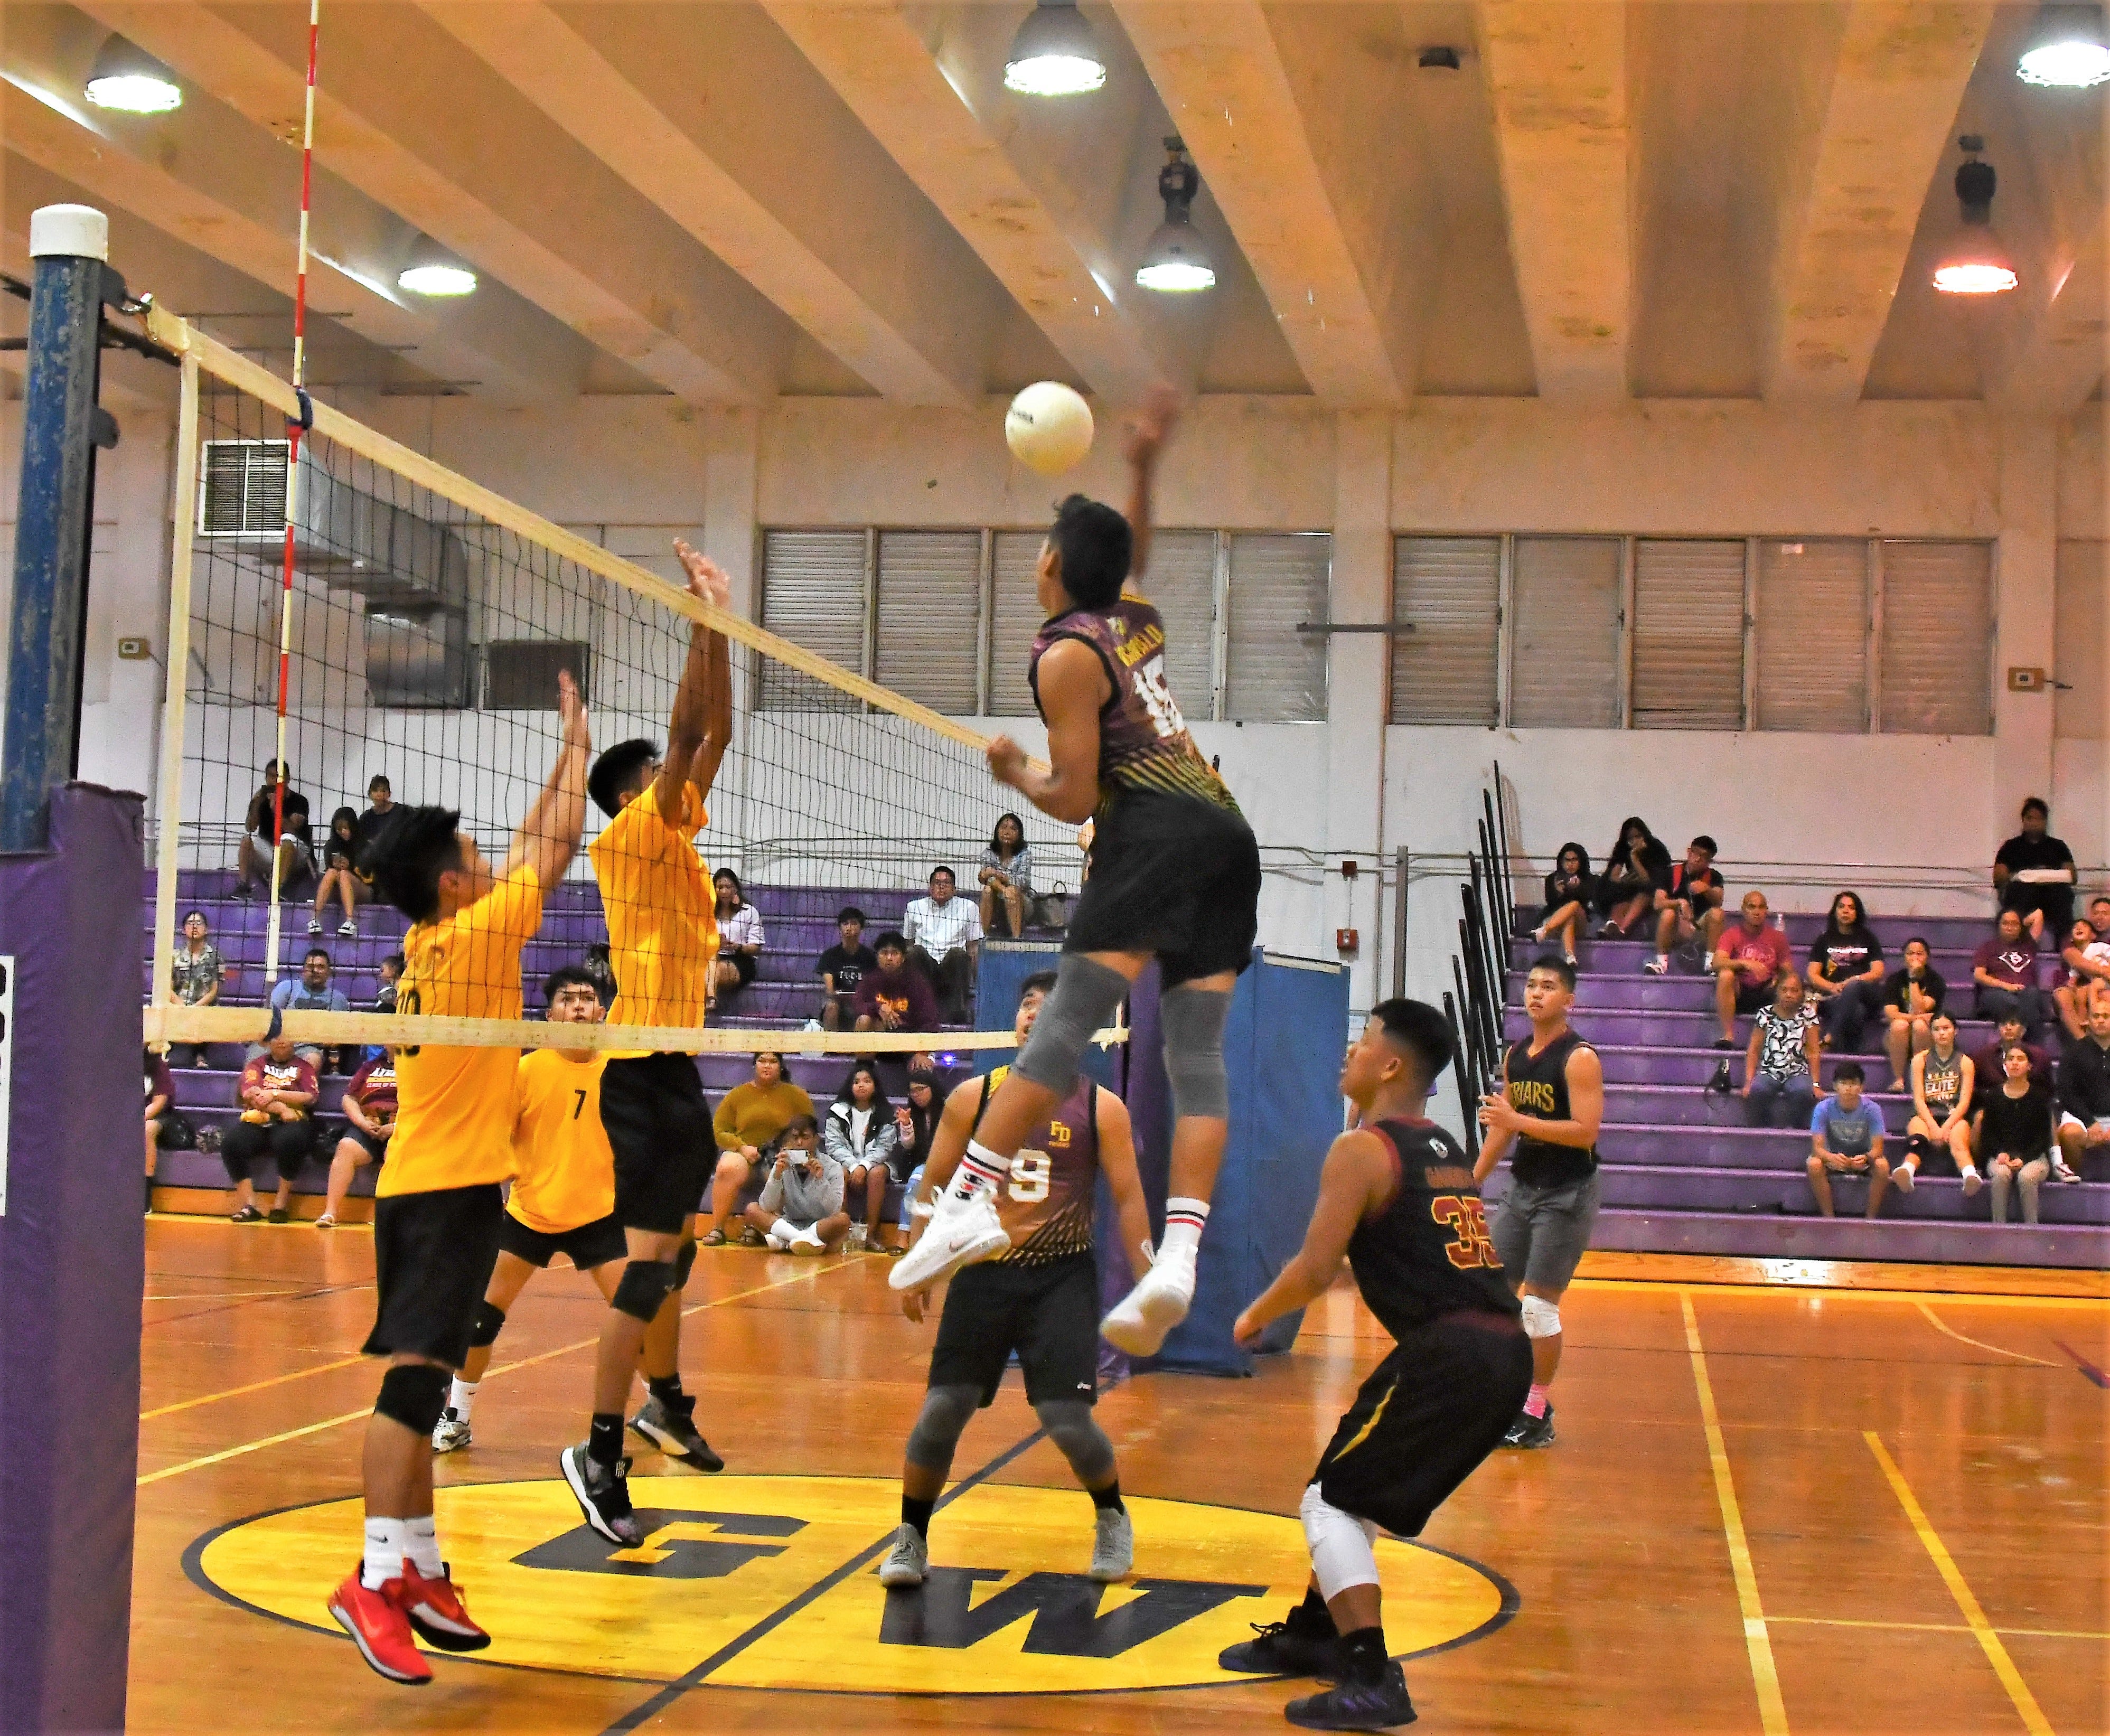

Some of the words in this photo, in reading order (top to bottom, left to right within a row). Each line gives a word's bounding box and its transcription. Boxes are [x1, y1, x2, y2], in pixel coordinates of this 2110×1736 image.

[574, 1089, 587, 1120] 7
[1509, 1081, 1555, 1113] RIARS
[1051, 1121, 1071, 1142] FD
[1008, 1148, 1052, 1203] 9
[509, 1508, 811, 1579] G
[869, 1564, 1272, 1658] W
